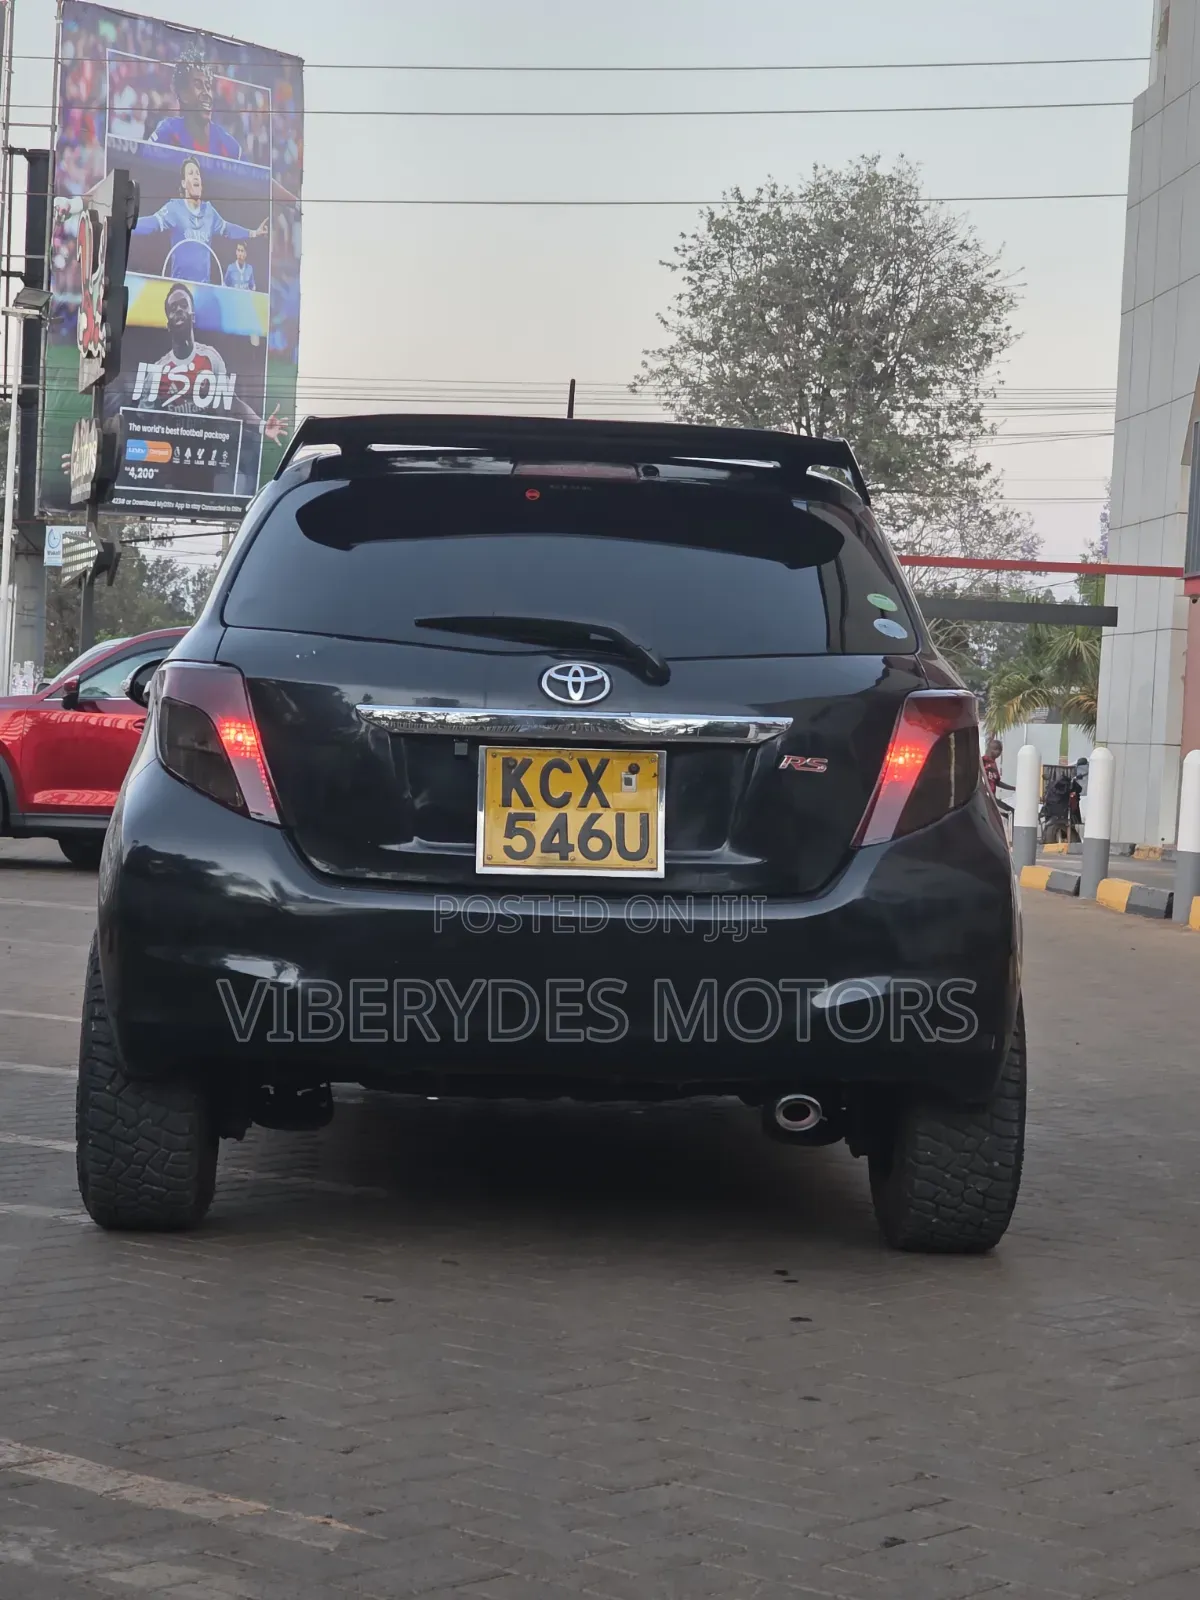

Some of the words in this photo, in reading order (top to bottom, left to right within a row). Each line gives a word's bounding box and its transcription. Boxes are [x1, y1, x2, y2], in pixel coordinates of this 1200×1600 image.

[132, 362, 191, 407] IT'S
[193, 369, 237, 411] ON
[128, 422, 141, 432] The
[142, 425, 164, 434] world's
[165, 426, 180, 435] best
[180, 428, 203, 438] football
[204, 431, 230, 442] package
[128, 466, 154, 480] 4,200
[132, 498, 156, 507] Download
[174, 502, 185, 511] App
[778, 754, 829, 772] RS
[501, 756, 611, 809] KCX
[502, 812, 650, 862] 546U
